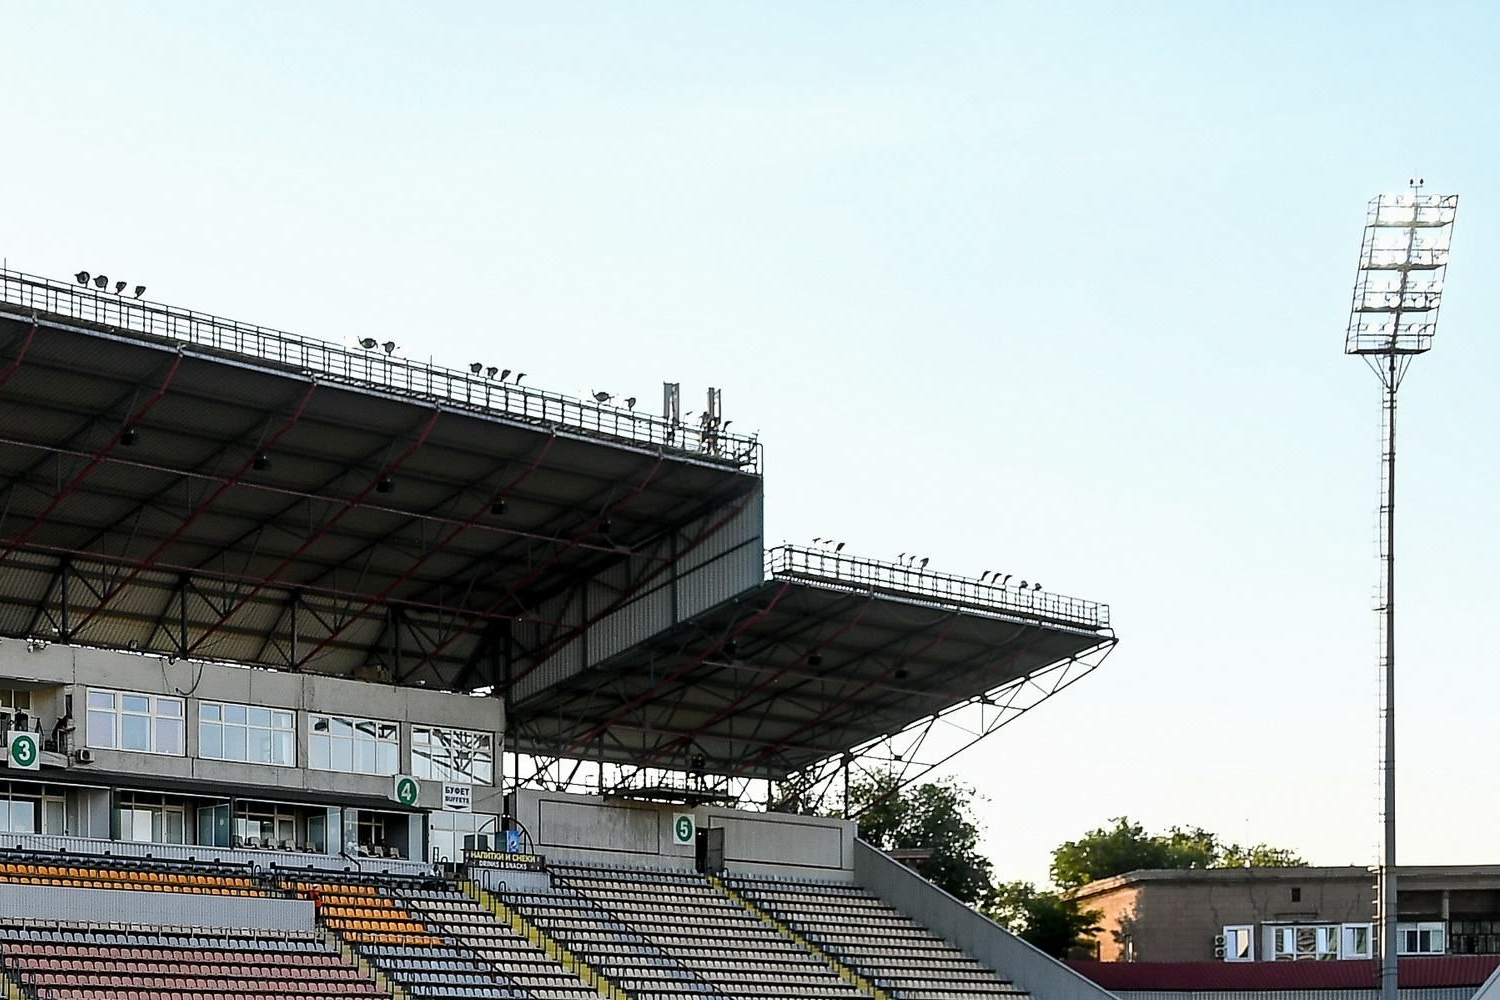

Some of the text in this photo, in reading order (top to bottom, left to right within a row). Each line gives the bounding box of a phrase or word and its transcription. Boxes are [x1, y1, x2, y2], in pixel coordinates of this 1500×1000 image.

[19, 741, 30, 760] 3
[401, 782, 412, 801] 4
[445, 786, 470, 796] БУФЕТ
[680, 821, 688, 837] 5
[470, 851, 504, 861] НАПИТКИ
[512, 854, 536, 863] СНЕКИ
